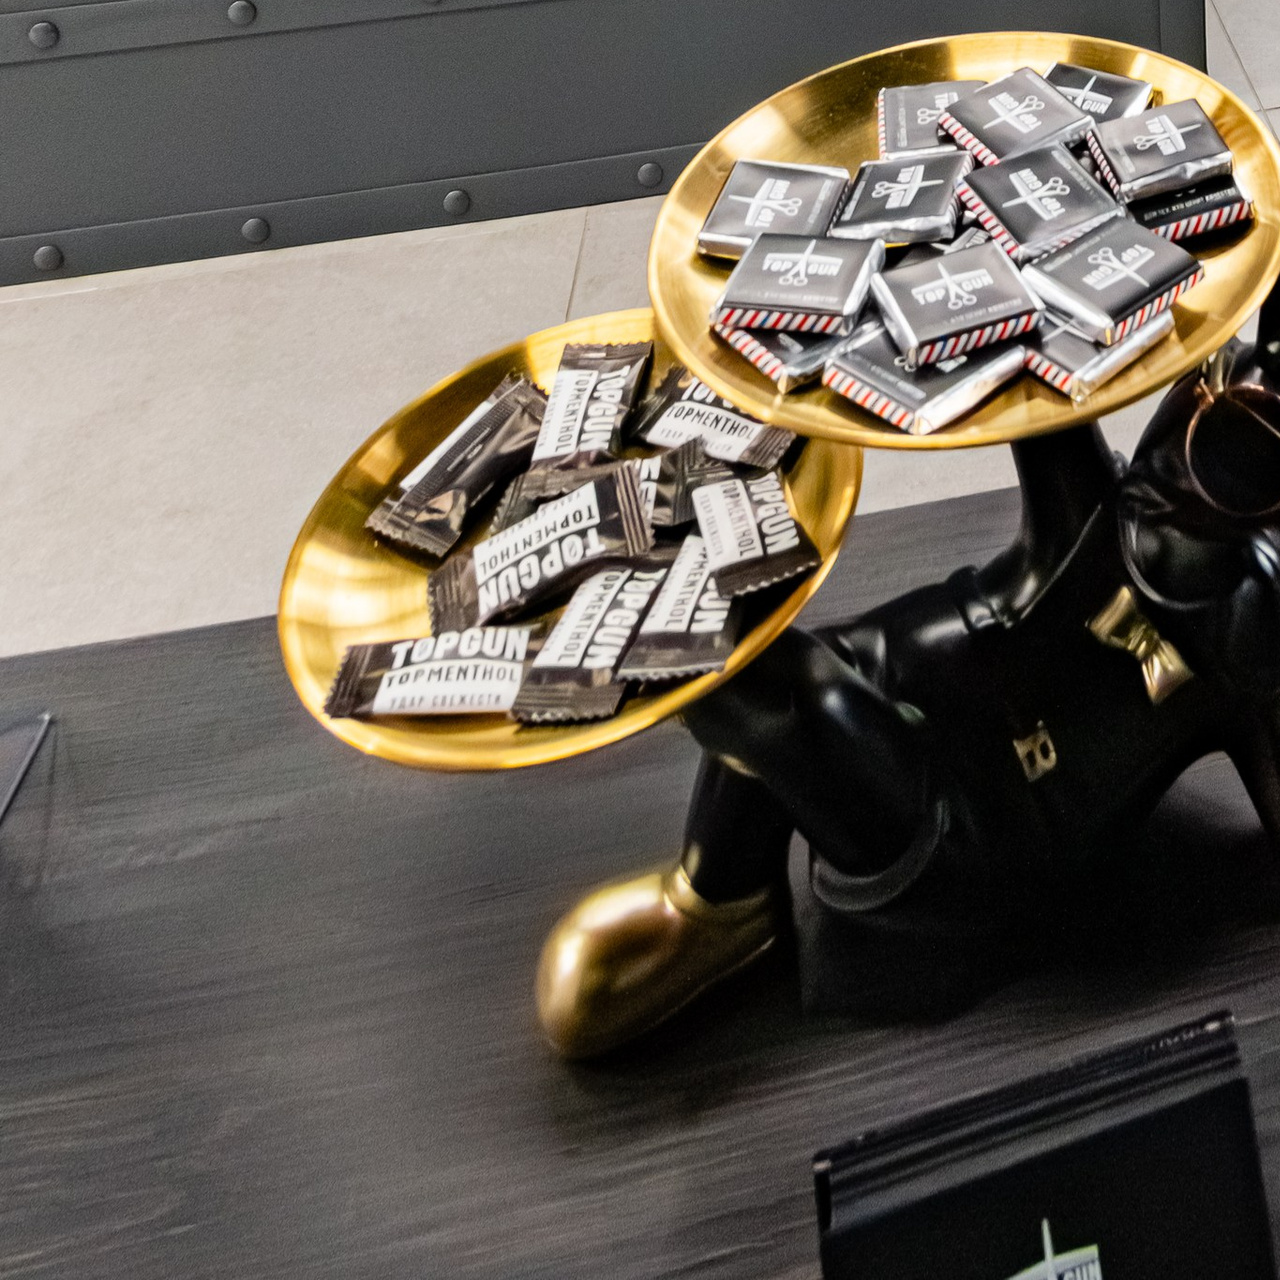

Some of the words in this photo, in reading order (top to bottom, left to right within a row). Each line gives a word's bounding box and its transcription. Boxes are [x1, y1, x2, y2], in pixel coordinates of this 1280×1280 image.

[1081, 100, 1110, 115] GUN
[762, 259, 793, 273] TOP
[807, 263, 841, 277] GUN
[913, 288, 946, 306] TOP
[961, 272, 995, 292] GUN
[555, 371, 594, 453] TOPMENTHOL
[576, 364, 631, 452] TOPGUN
[666, 405, 756, 440] TOPMENTHOL
[479, 504, 596, 575] TOPMENTHOL
[720, 480, 757, 557] TOPMENTHOL
[746, 471, 800, 556] TOPGUN
[478, 527, 607, 619] TOPGUN
[390, 626, 532, 671] TOPGUN
[557, 574, 621, 662] OPMENTHOL
[581, 567, 669, 669] TOPGUN
[387, 664, 518, 688] TOPMENTHOL
